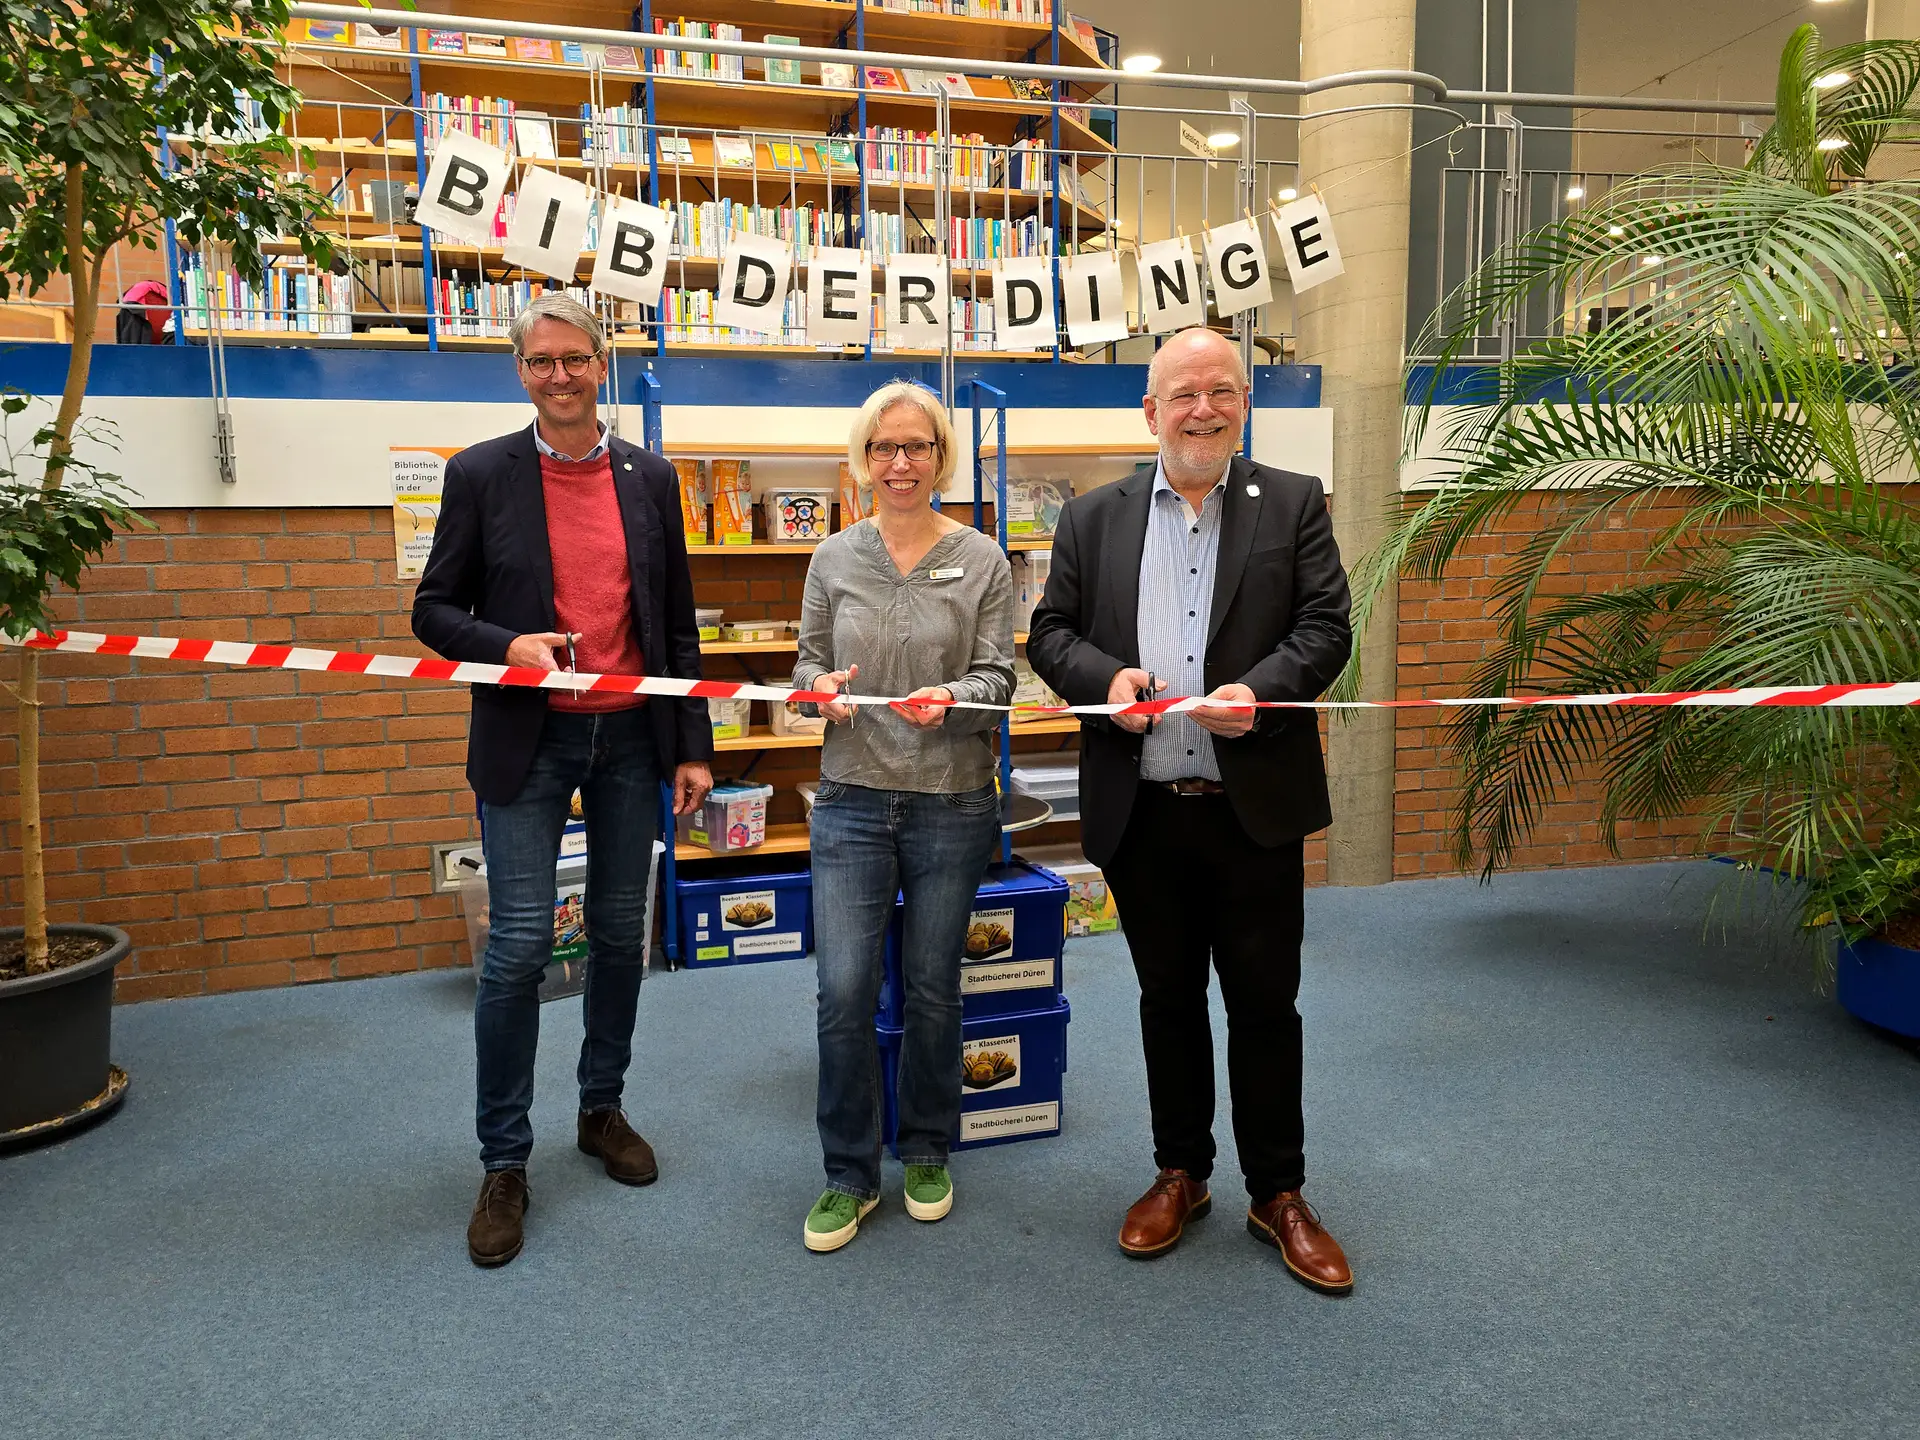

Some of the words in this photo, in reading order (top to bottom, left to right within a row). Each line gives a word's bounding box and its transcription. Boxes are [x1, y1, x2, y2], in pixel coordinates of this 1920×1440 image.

[394, 461, 439, 469] Bibliothek
[412, 474, 438, 483] Dinge
[975, 909, 1013, 918] Klassenset
[739, 940, 778, 949] Stadtbücherei
[780, 938, 797, 946] Düren
[967, 971, 1021, 983] Stadtbücherei
[1023, 969, 1046, 978] Düren
[978, 1036, 1016, 1048] Klassenset
[970, 1117, 1024, 1130] Stadtbücherei
[1025, 1114, 1048, 1123] Düren
